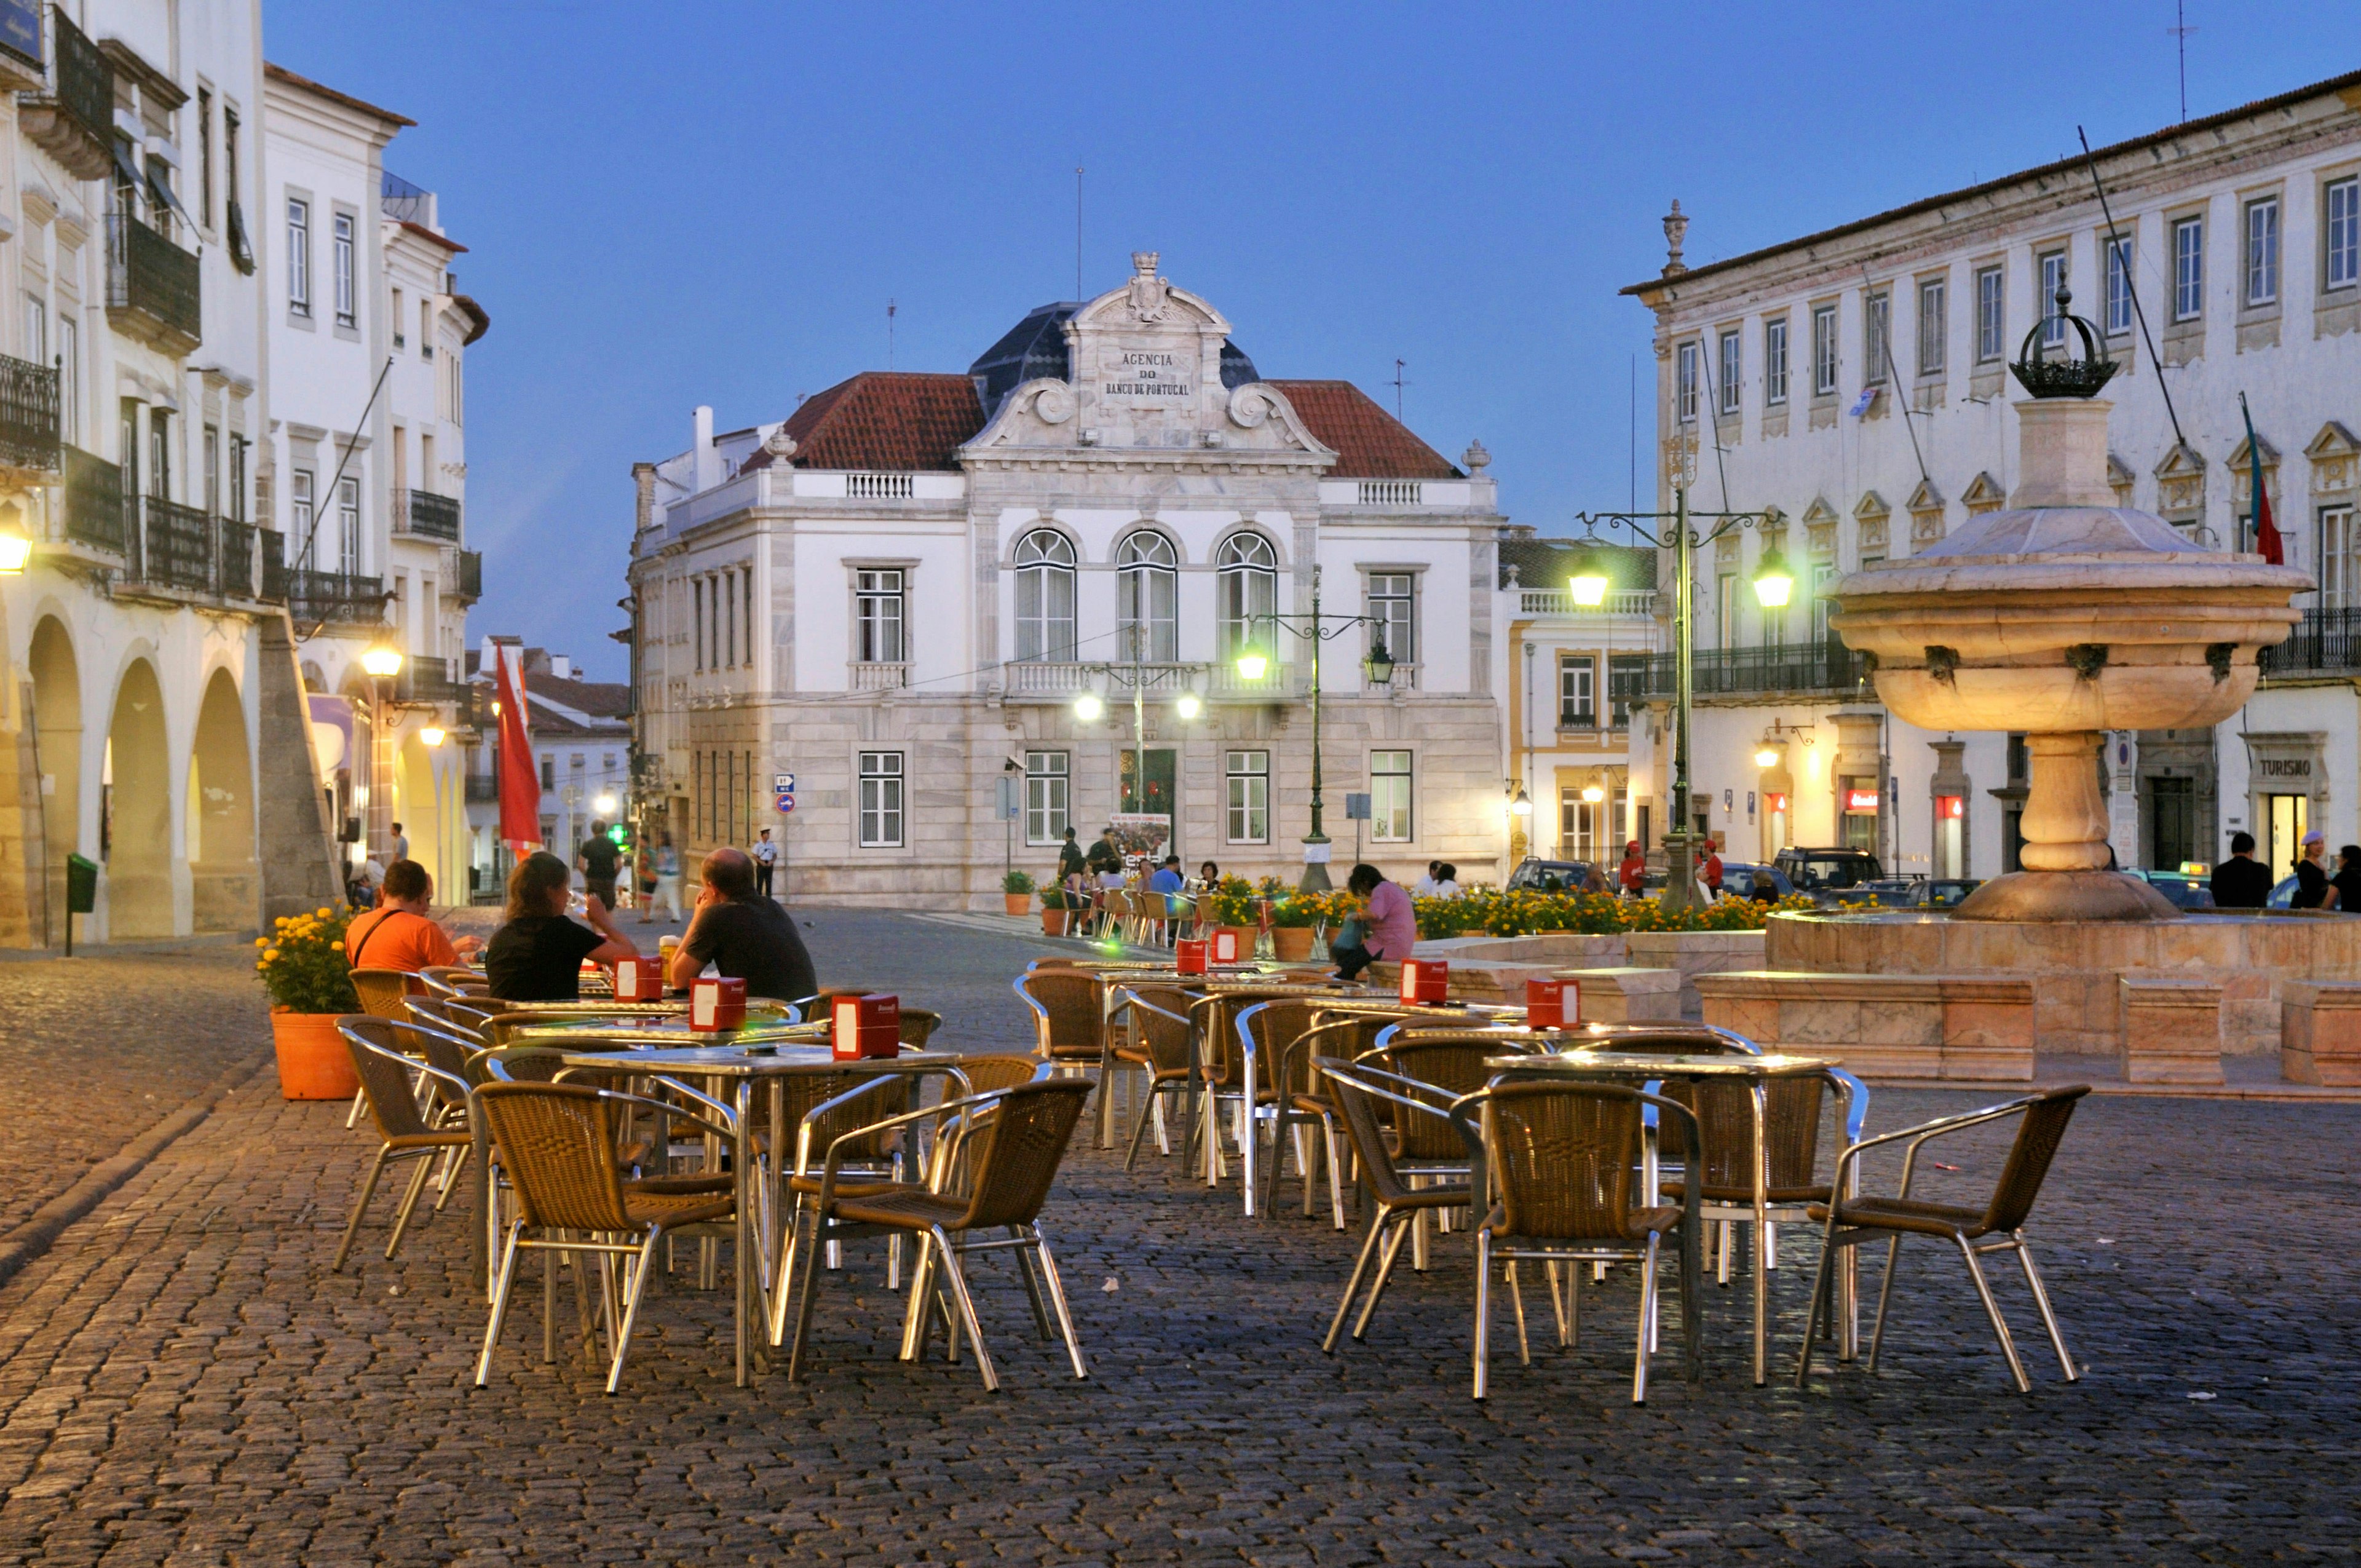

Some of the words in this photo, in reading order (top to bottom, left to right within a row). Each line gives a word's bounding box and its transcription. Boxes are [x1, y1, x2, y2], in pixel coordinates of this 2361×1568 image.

[1123, 354, 1173, 366] AGENCIA
[1139, 370, 1156, 379] DO
[1106, 383, 1133, 394] BANCO
[1134, 384, 1145, 394] DE
[2260, 759, 2311, 776] TURISMO
